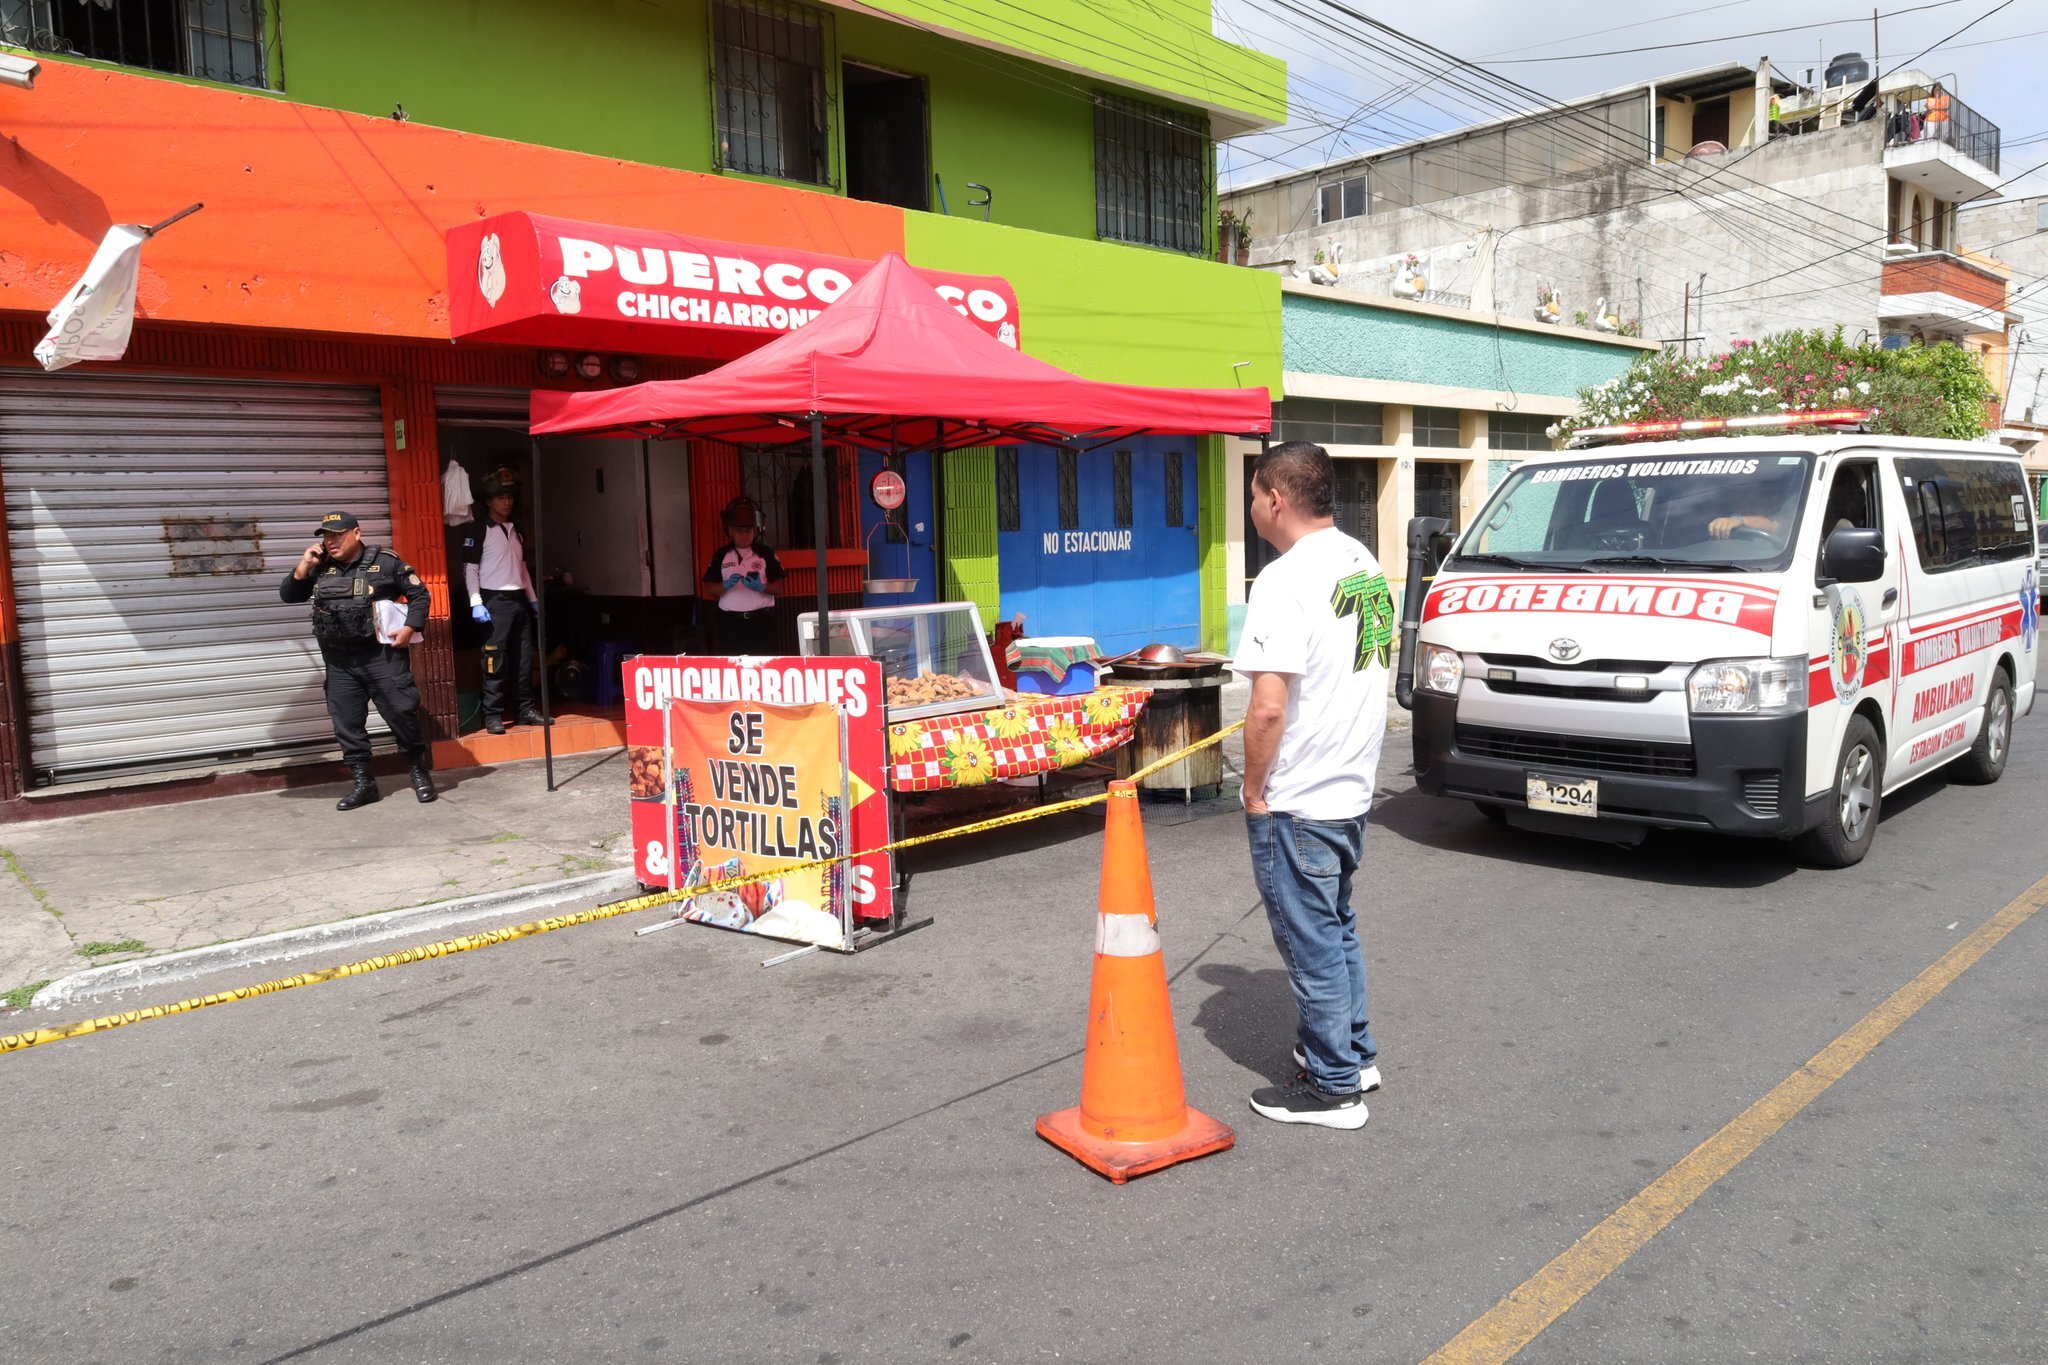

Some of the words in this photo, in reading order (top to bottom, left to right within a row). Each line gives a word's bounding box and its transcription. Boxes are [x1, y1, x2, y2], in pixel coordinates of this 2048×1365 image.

[558, 237, 853, 303] PUERCO
[1530, 463, 1627, 484] BOMBEROS
[1627, 459, 1759, 477] VOLUNTARIOS
[1043, 532, 1059, 555] NO
[1064, 530, 1132, 553] ESTACIONAR
[1914, 631, 1957, 671] BOMBEROS
[1959, 617, 2003, 655] VOLUNTARIOS
[635, 667, 868, 717] CHICHARRONES
[1912, 672, 1974, 724] AMBULANCIA
[729, 711, 764, 755] SE
[708, 758, 799, 810] VENDE
[1546, 786, 1593, 808] 1294
[685, 802, 839, 861] TORTILLAS
